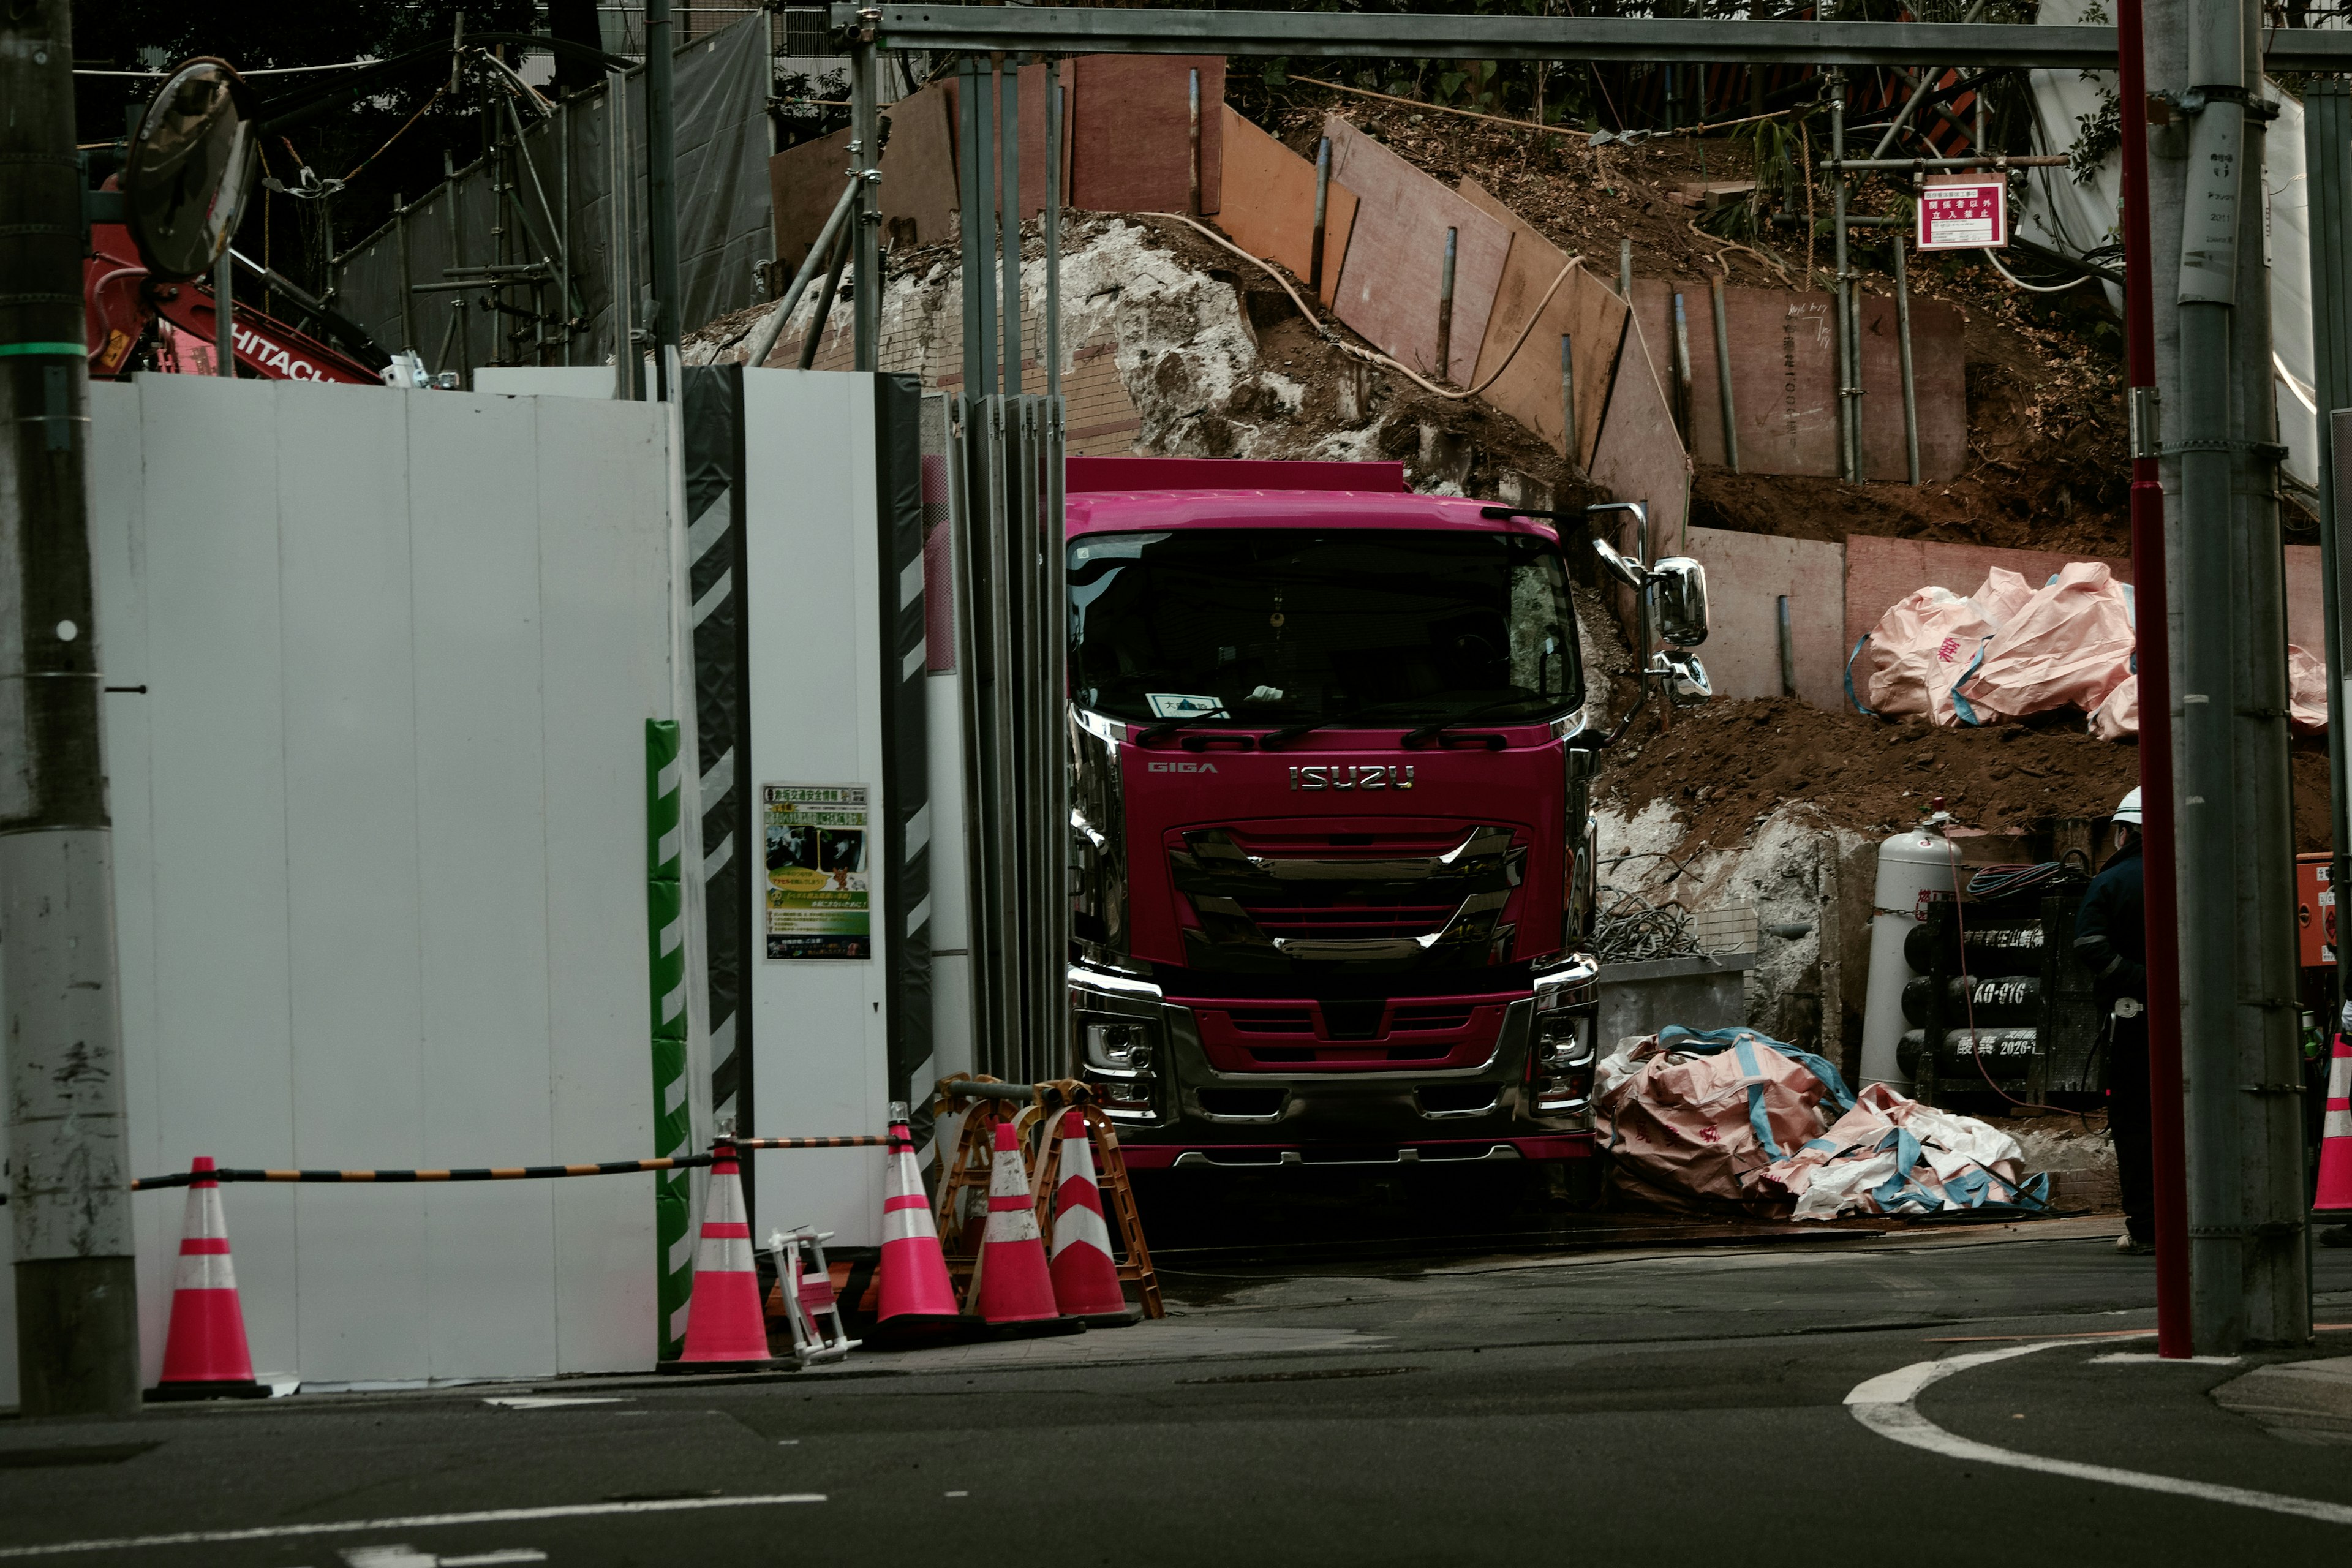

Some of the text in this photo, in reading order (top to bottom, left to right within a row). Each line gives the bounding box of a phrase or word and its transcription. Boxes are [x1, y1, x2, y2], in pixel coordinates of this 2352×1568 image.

[1929, 198, 1992, 209] 関係者以外
[1932, 209, 1989, 219] 立入禁止
[1148, 762, 1218, 774] GIGA
[1289, 765, 1414, 791] ISUZU
[1956, 1036, 1997, 1056] 酸素
